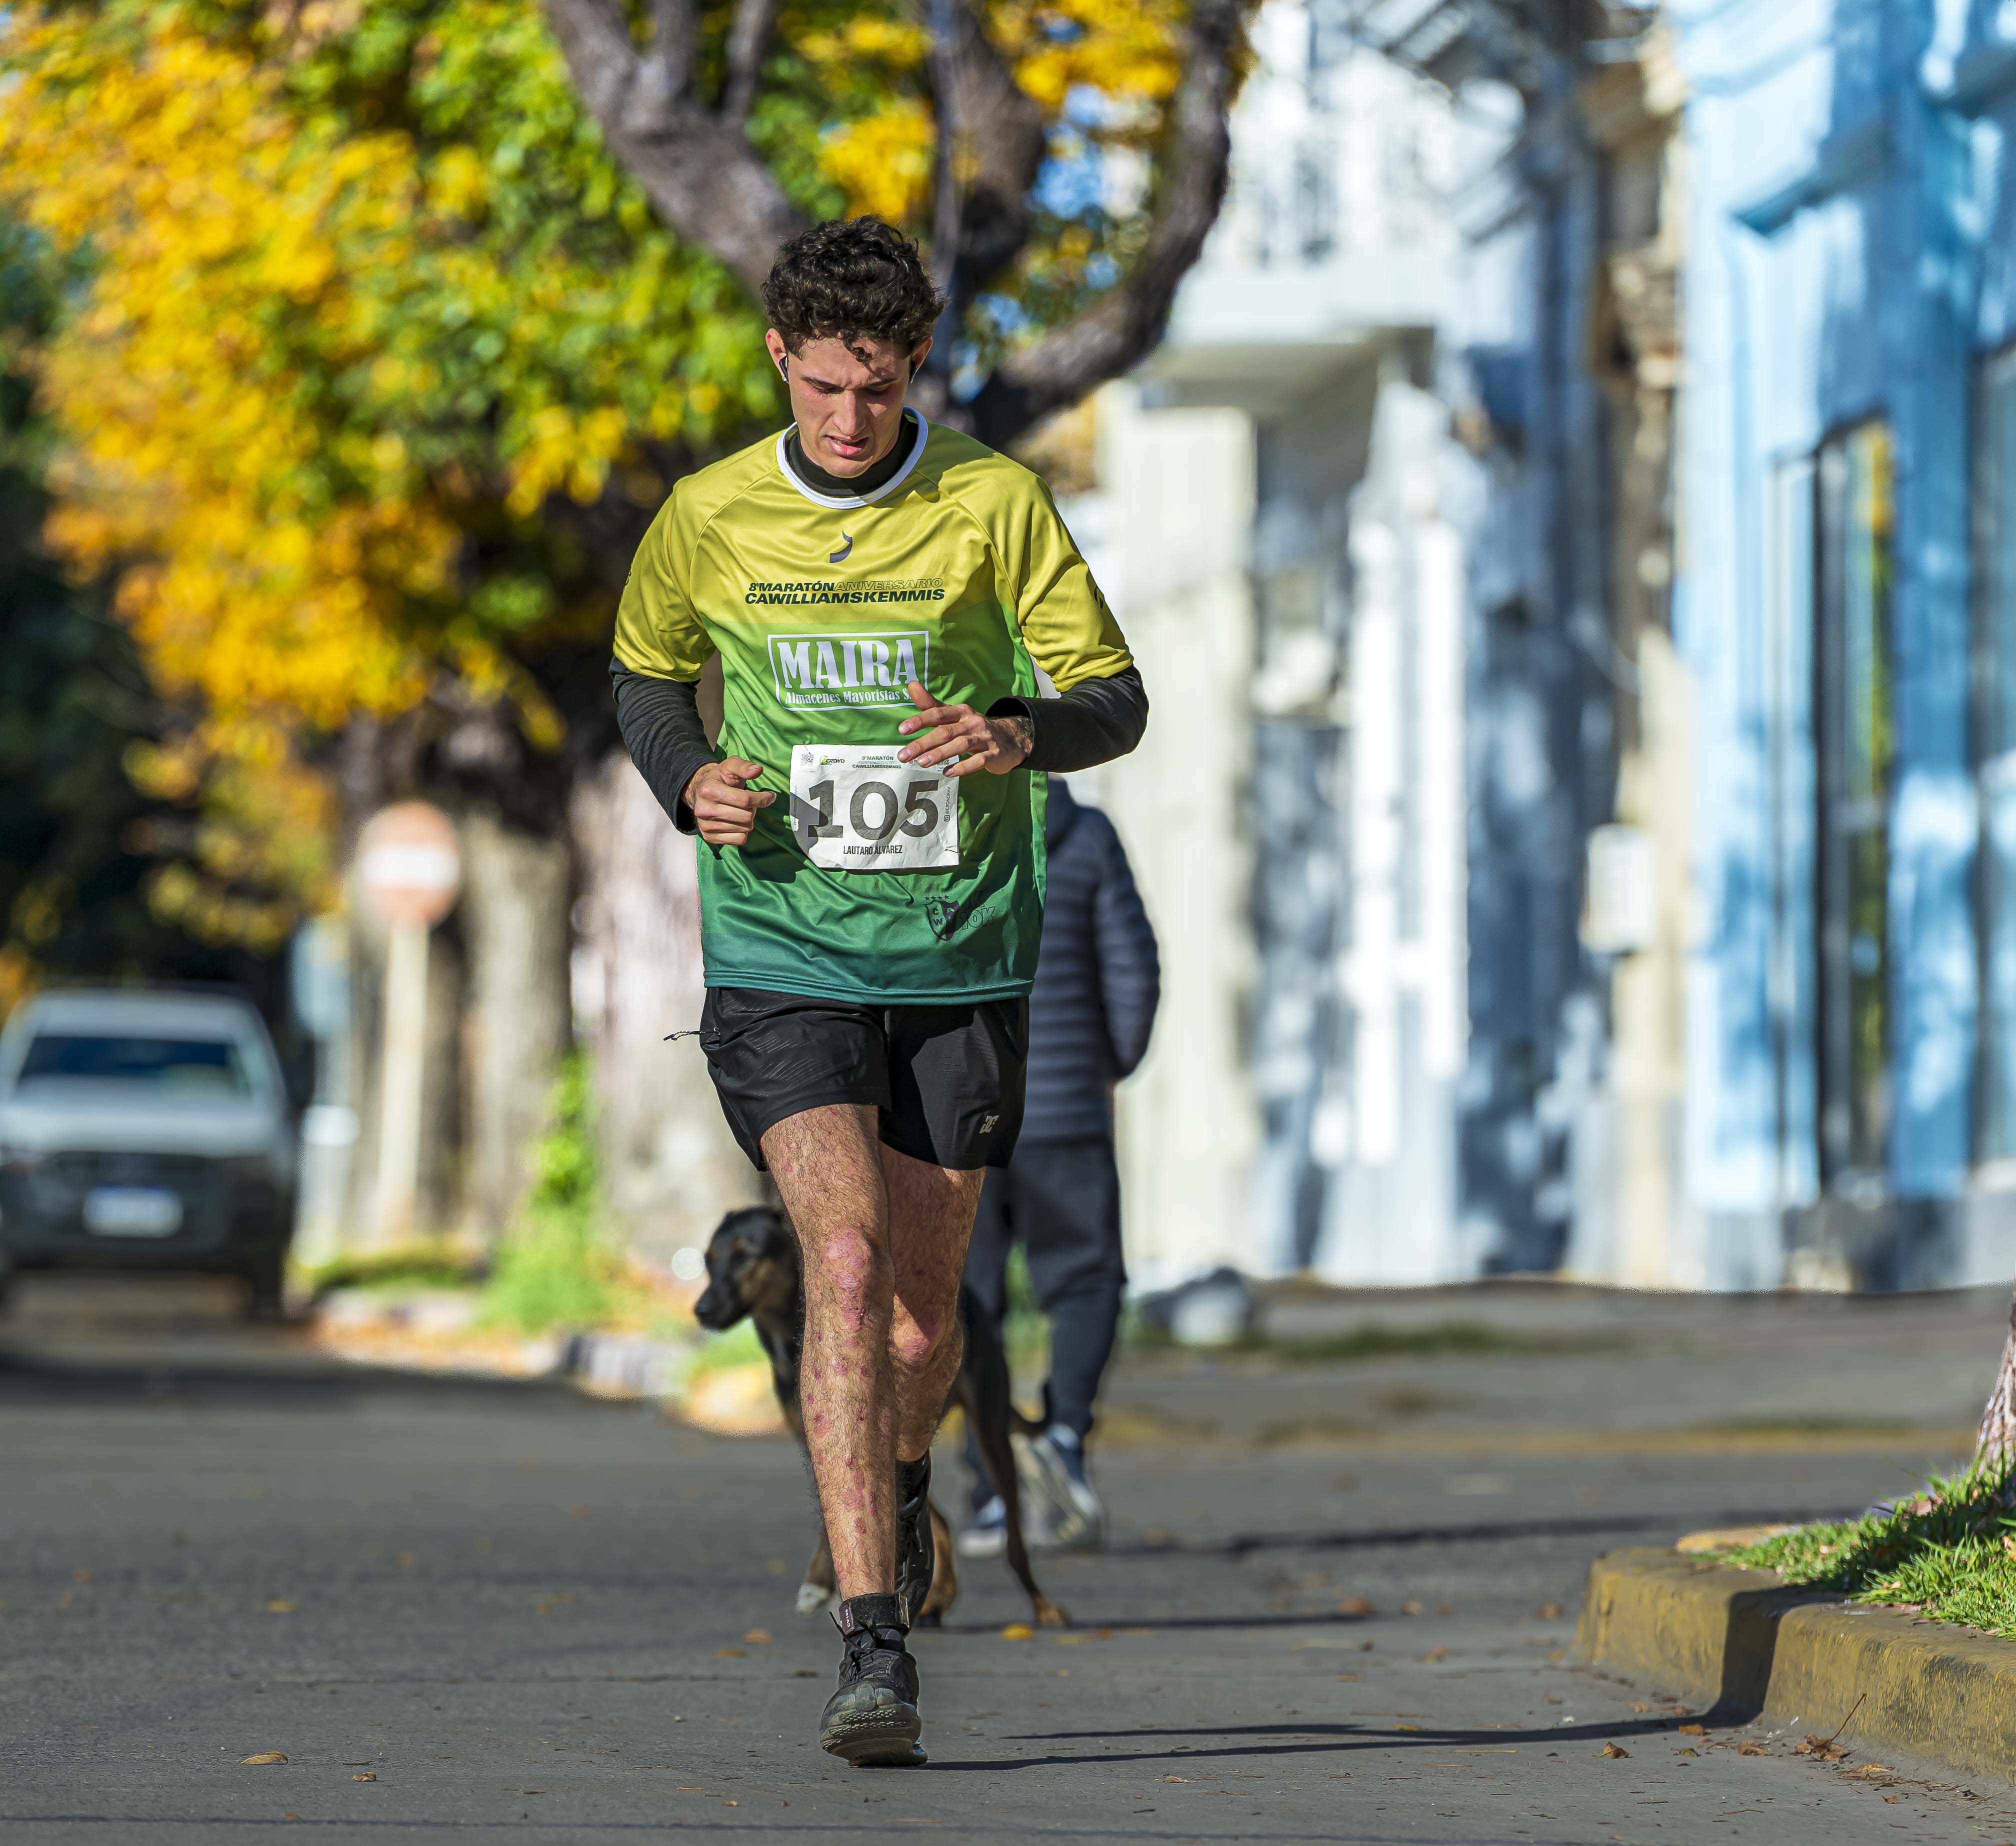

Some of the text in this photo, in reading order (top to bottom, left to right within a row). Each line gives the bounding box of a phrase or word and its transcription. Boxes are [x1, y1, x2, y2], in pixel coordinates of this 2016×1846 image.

[777, 639, 919, 689] MAIRA
[784, 692, 840, 704] Almacenes
[842, 689, 900, 704] Mayoristas
[808, 780, 939, 840] 105
[843, 846, 874, 855] LAUTARO
